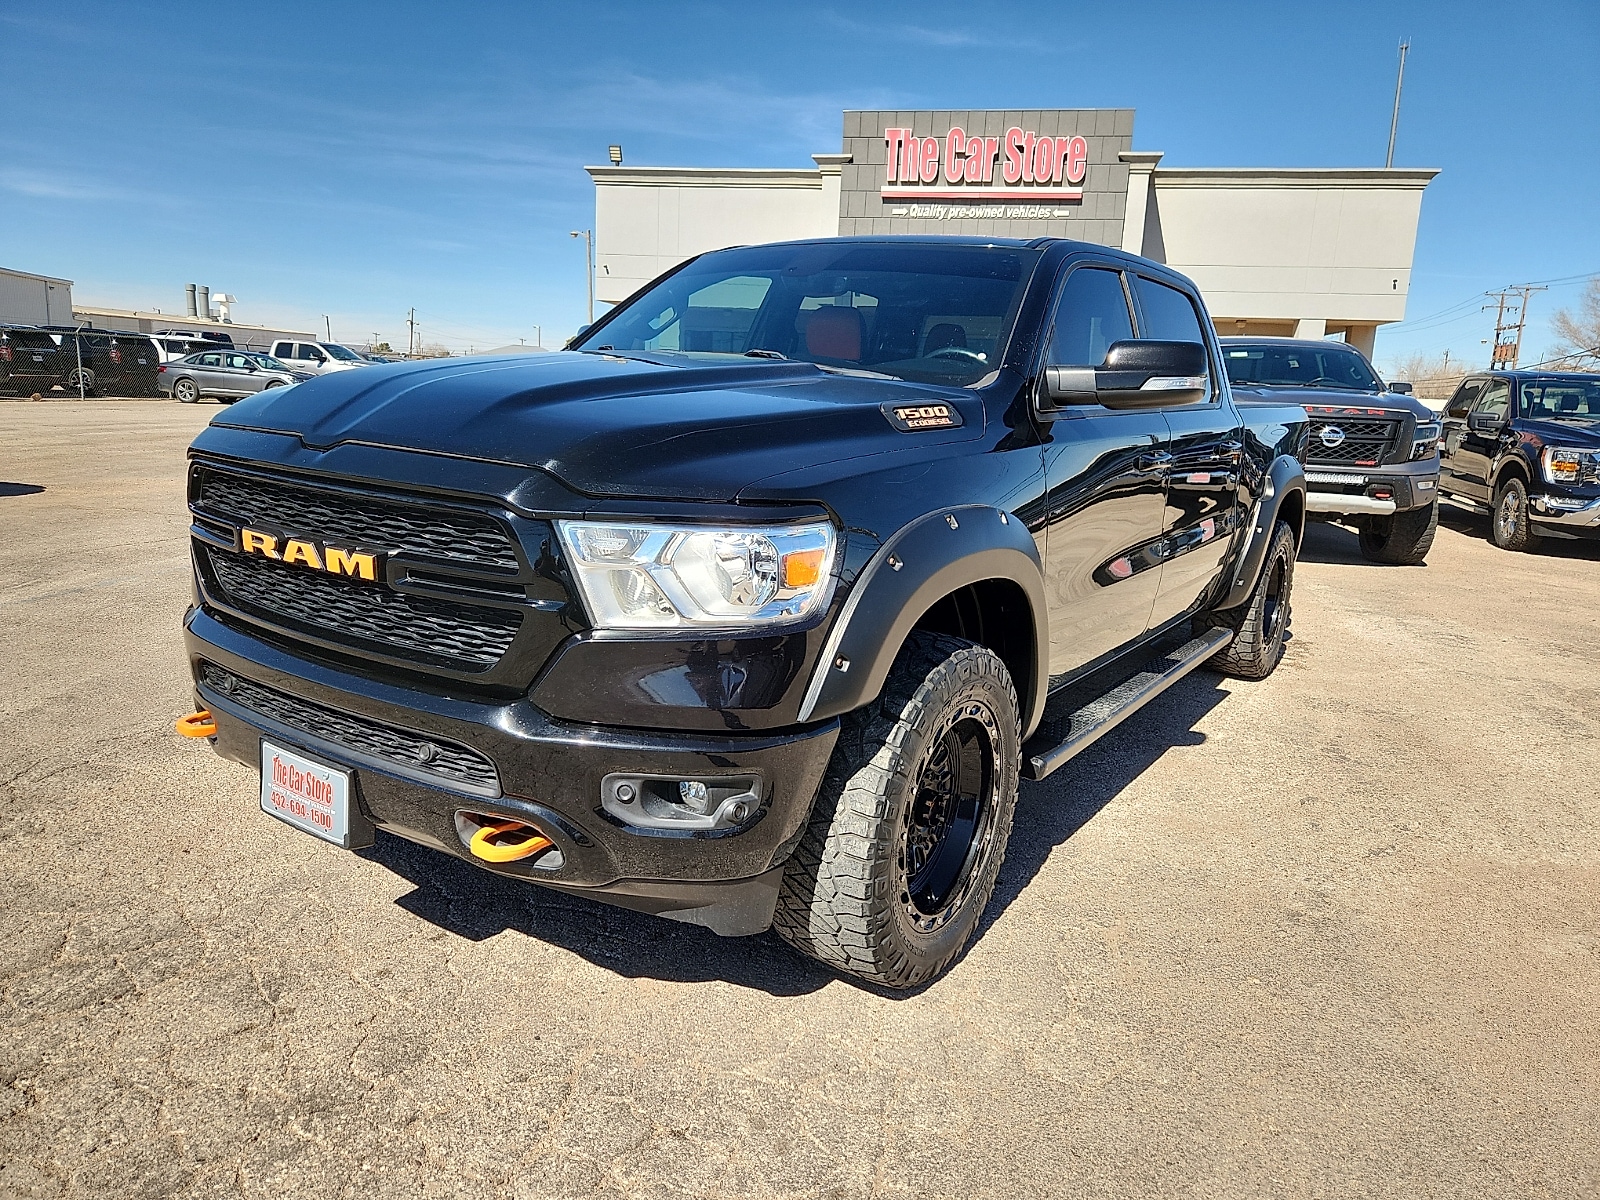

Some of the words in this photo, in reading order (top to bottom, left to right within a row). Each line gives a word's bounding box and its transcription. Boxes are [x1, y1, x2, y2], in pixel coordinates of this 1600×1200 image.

[885, 127, 939, 183] The
[944, 126, 999, 183] Car
[1003, 126, 1087, 183] Store
[909, 204, 947, 220] Quality
[948, 205, 1004, 220] pre-owned
[1006, 204, 1051, 218] vehicles
[894, 406, 948, 420] 1500
[241, 526, 377, 582] RAM
[273, 757, 287, 785] The
[289, 764, 304, 793] Car
[305, 771, 333, 805] Store
